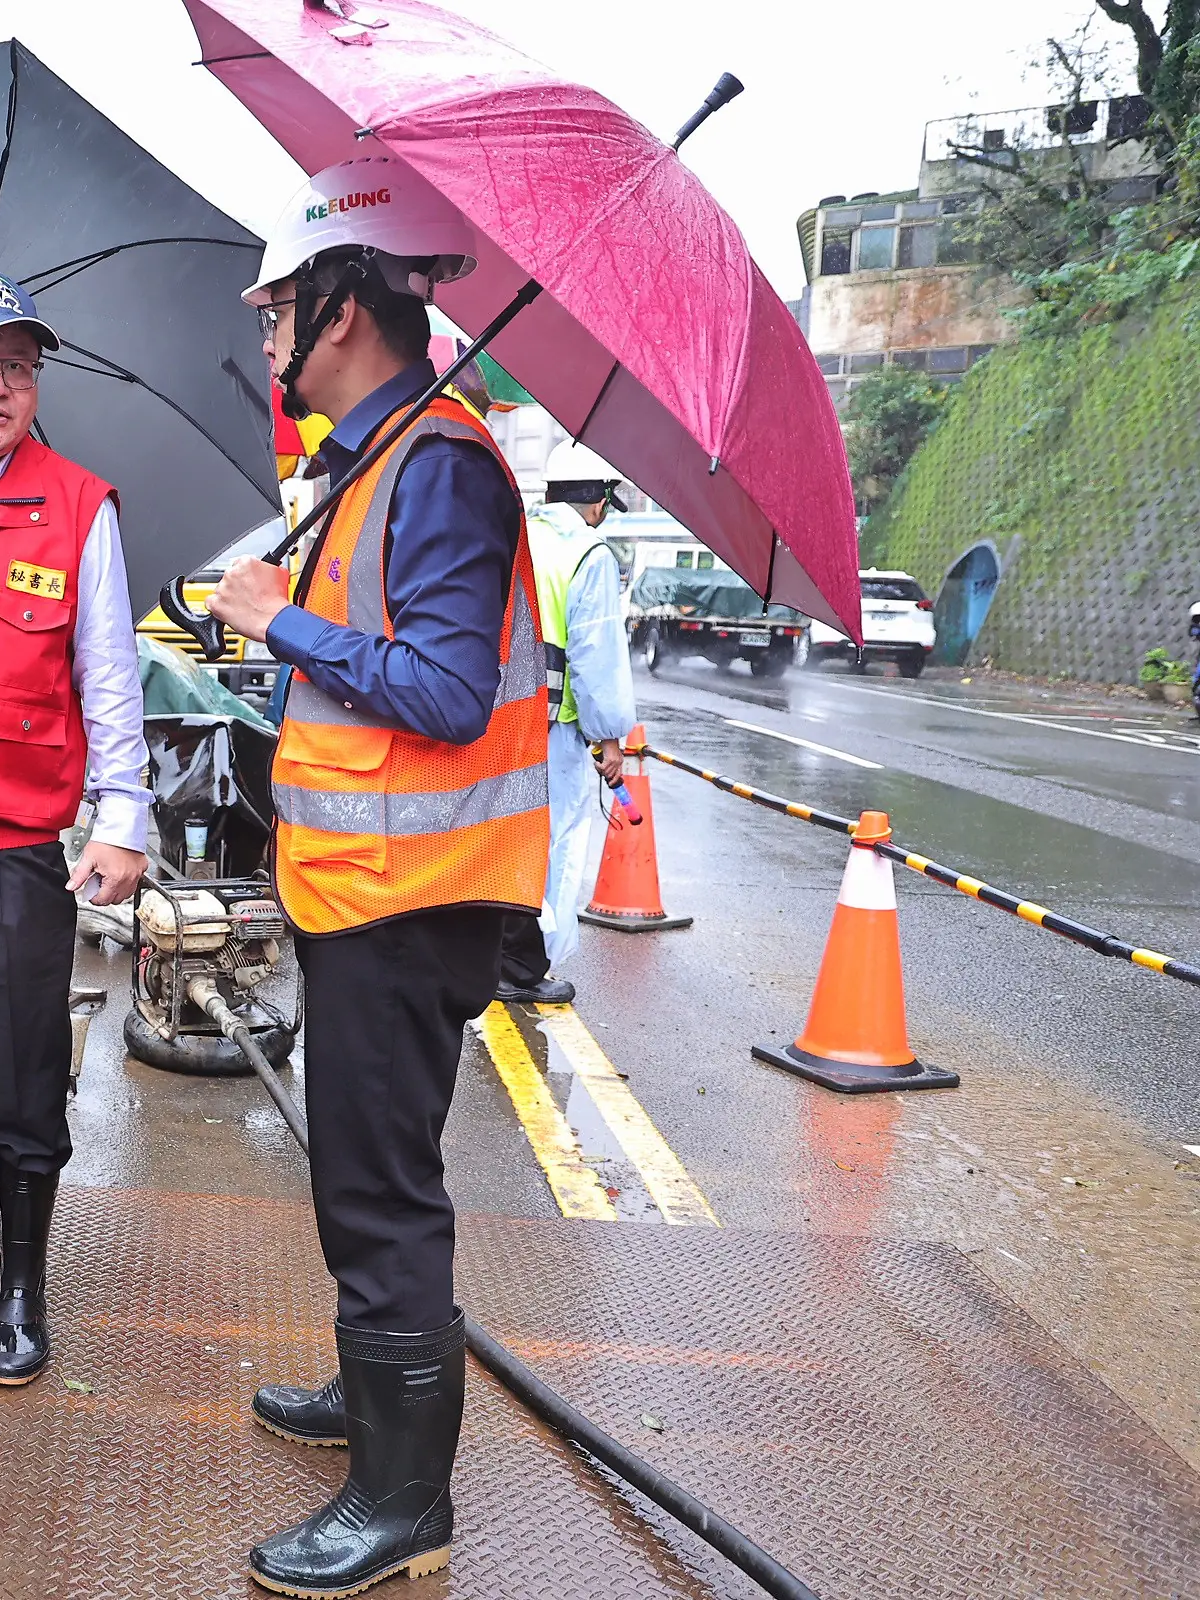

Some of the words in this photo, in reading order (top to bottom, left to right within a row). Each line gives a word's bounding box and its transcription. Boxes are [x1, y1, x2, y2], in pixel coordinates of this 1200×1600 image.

[305, 188, 392, 223] KEELUNG
[9, 567, 62, 594] 秘書長
